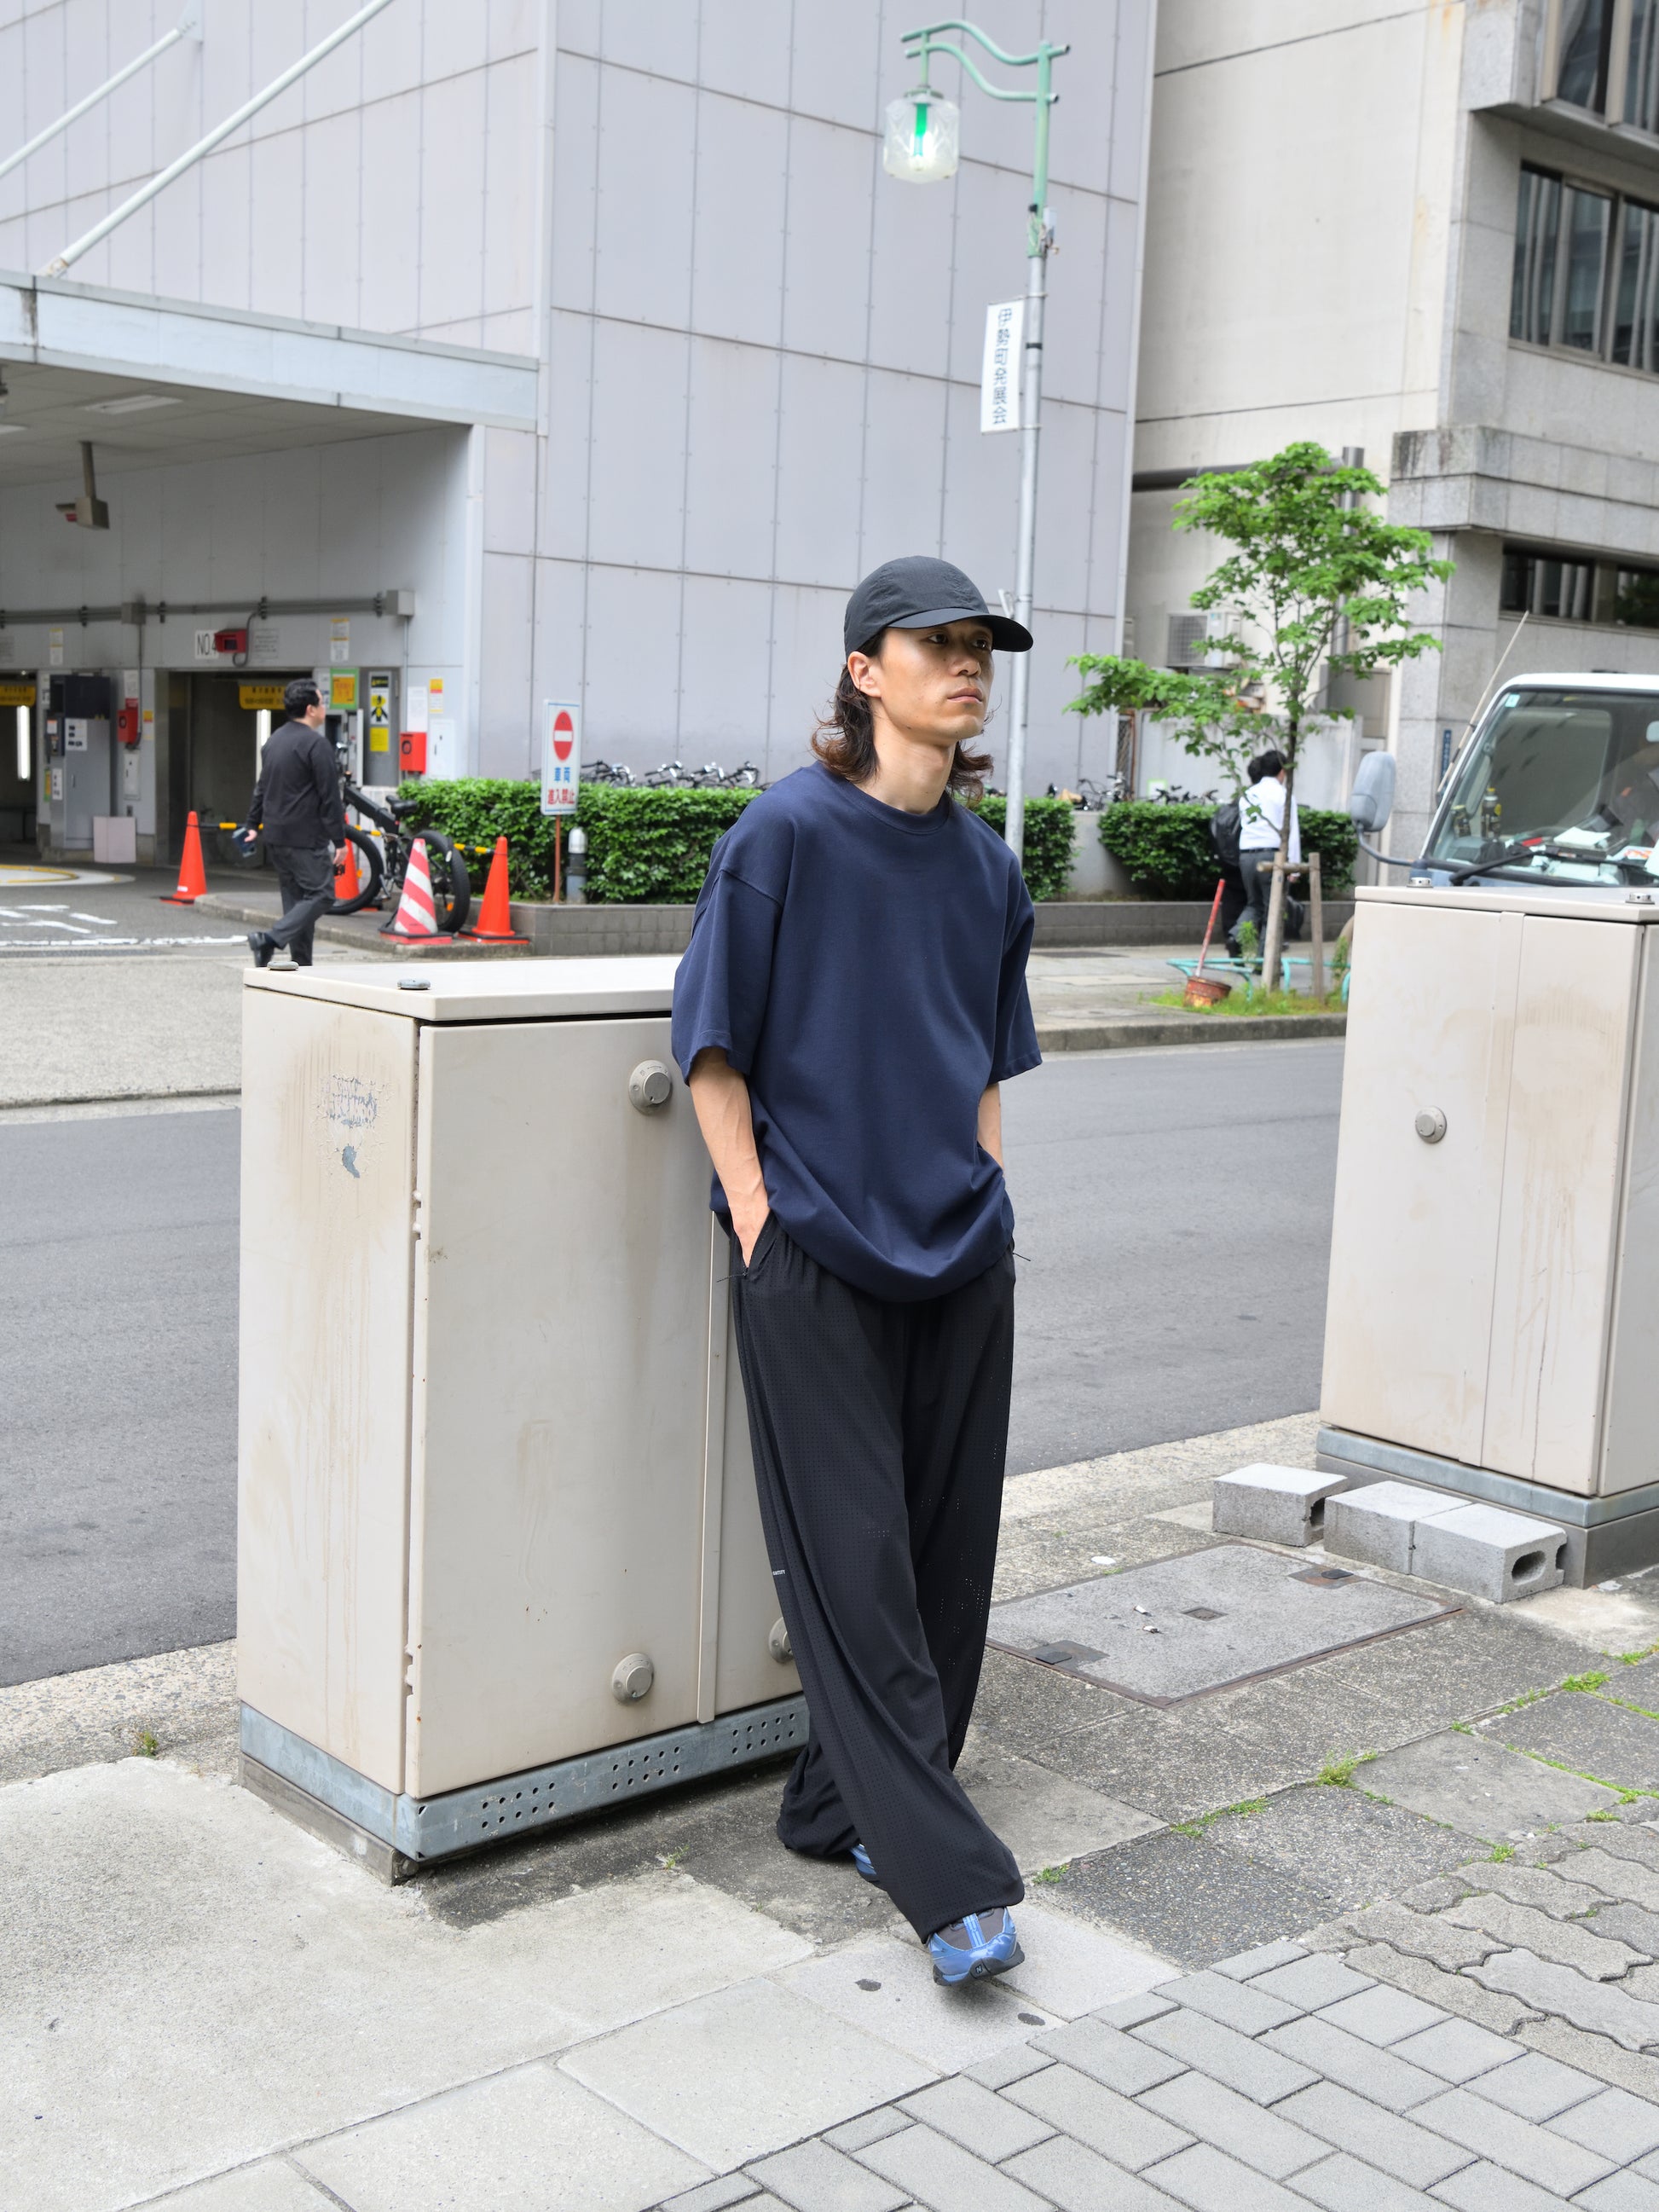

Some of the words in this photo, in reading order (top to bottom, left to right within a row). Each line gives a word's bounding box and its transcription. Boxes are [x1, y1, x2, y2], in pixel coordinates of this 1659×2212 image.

[554, 767, 570, 783] 車両
[547, 789, 575, 805] 進入禁止
